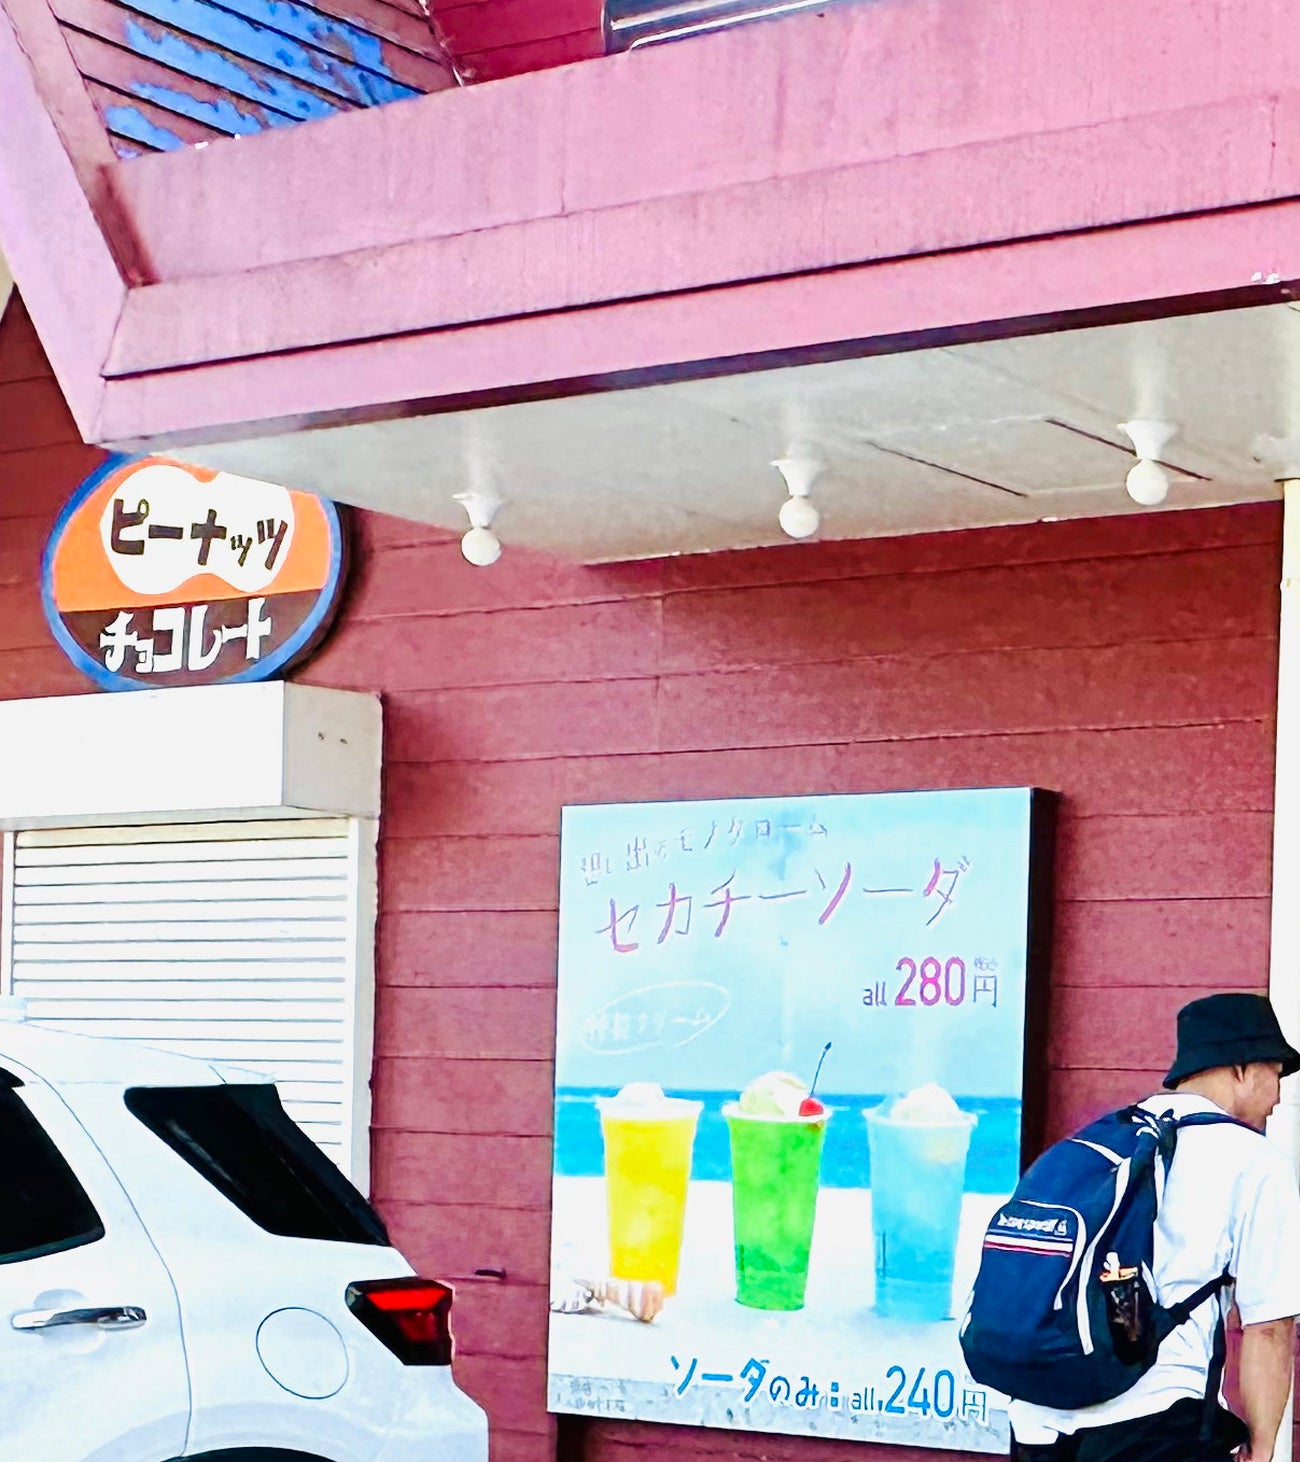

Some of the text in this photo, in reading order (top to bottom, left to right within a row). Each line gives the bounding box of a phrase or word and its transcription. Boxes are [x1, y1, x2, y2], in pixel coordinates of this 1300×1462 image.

[110, 498, 289, 571] ピーナッツ
[99, 597, 272, 674] チョコレート
[594, 856, 971, 953] セカチーソーダ
